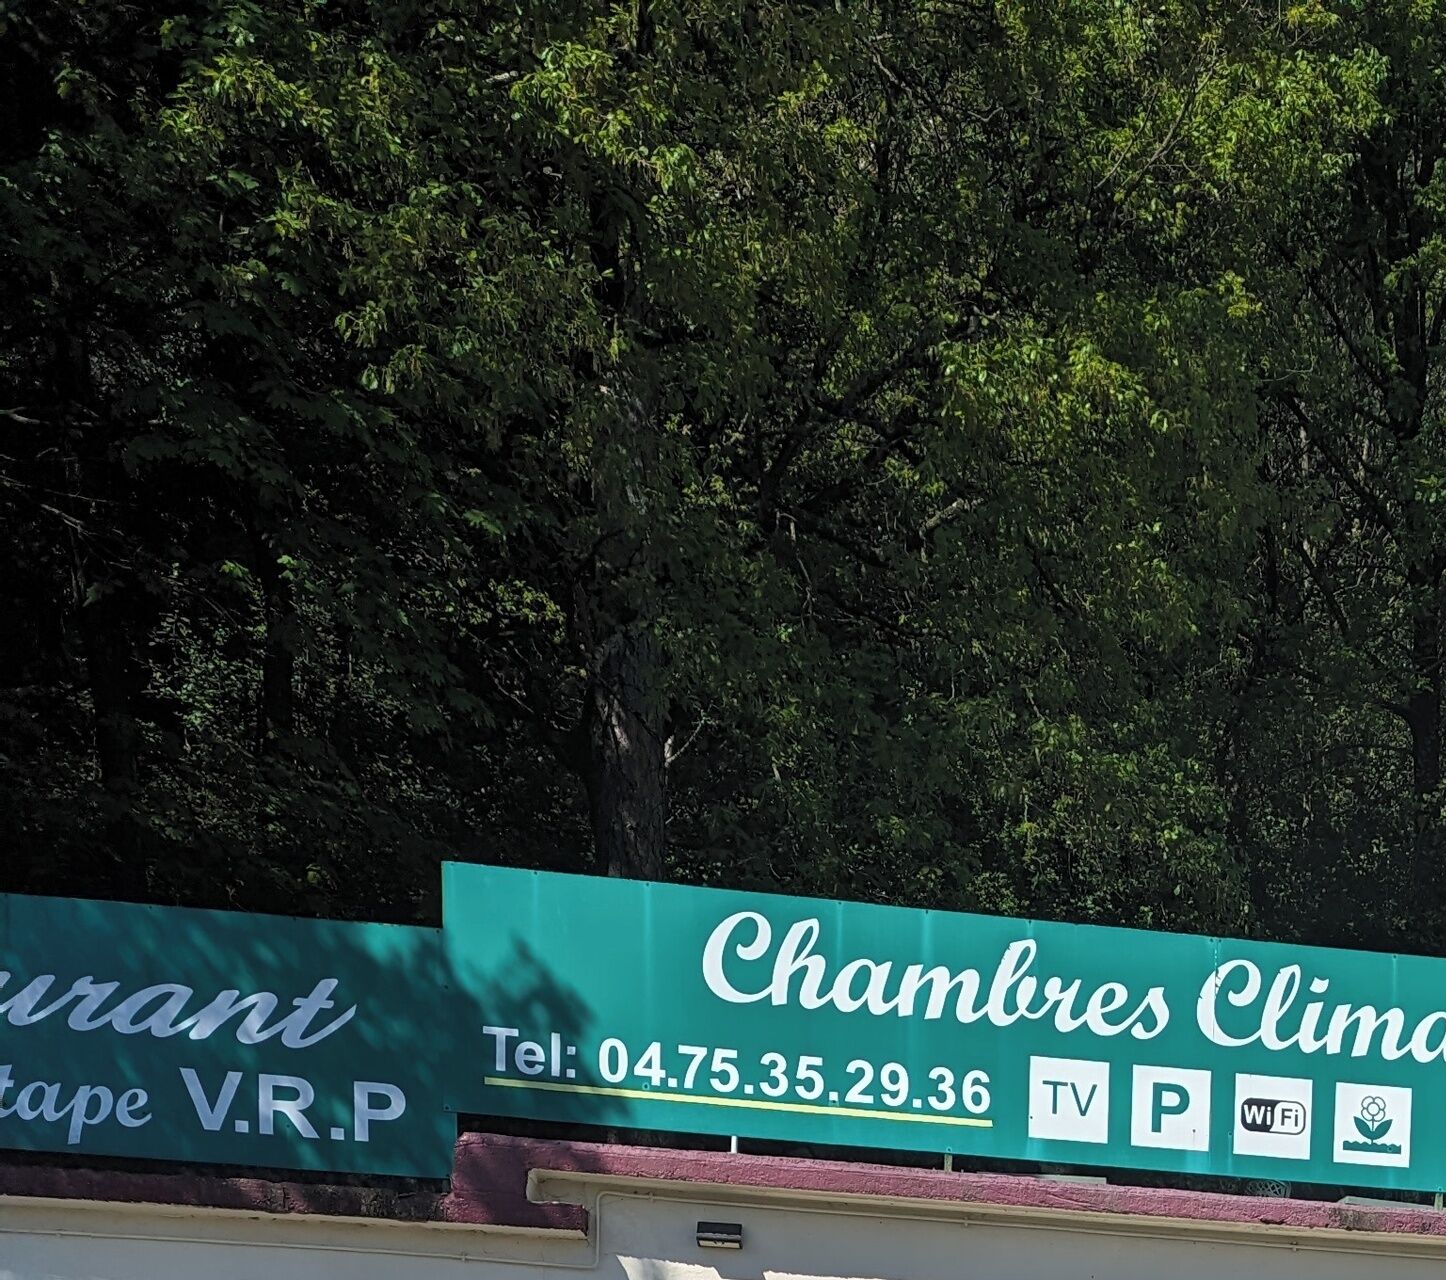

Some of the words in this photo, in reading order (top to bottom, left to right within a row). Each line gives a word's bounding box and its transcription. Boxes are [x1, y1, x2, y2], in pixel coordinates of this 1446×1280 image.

[702, 911, 1170, 1040] Chambres
[179, 1067, 406, 1142] V.R.P
[483, 1026, 577, 1079] Tel:
[598, 1037, 992, 1114] 04.75.35.29.36
[1042, 1079, 1099, 1118] TV
[1151, 1082, 1190, 1132] P
